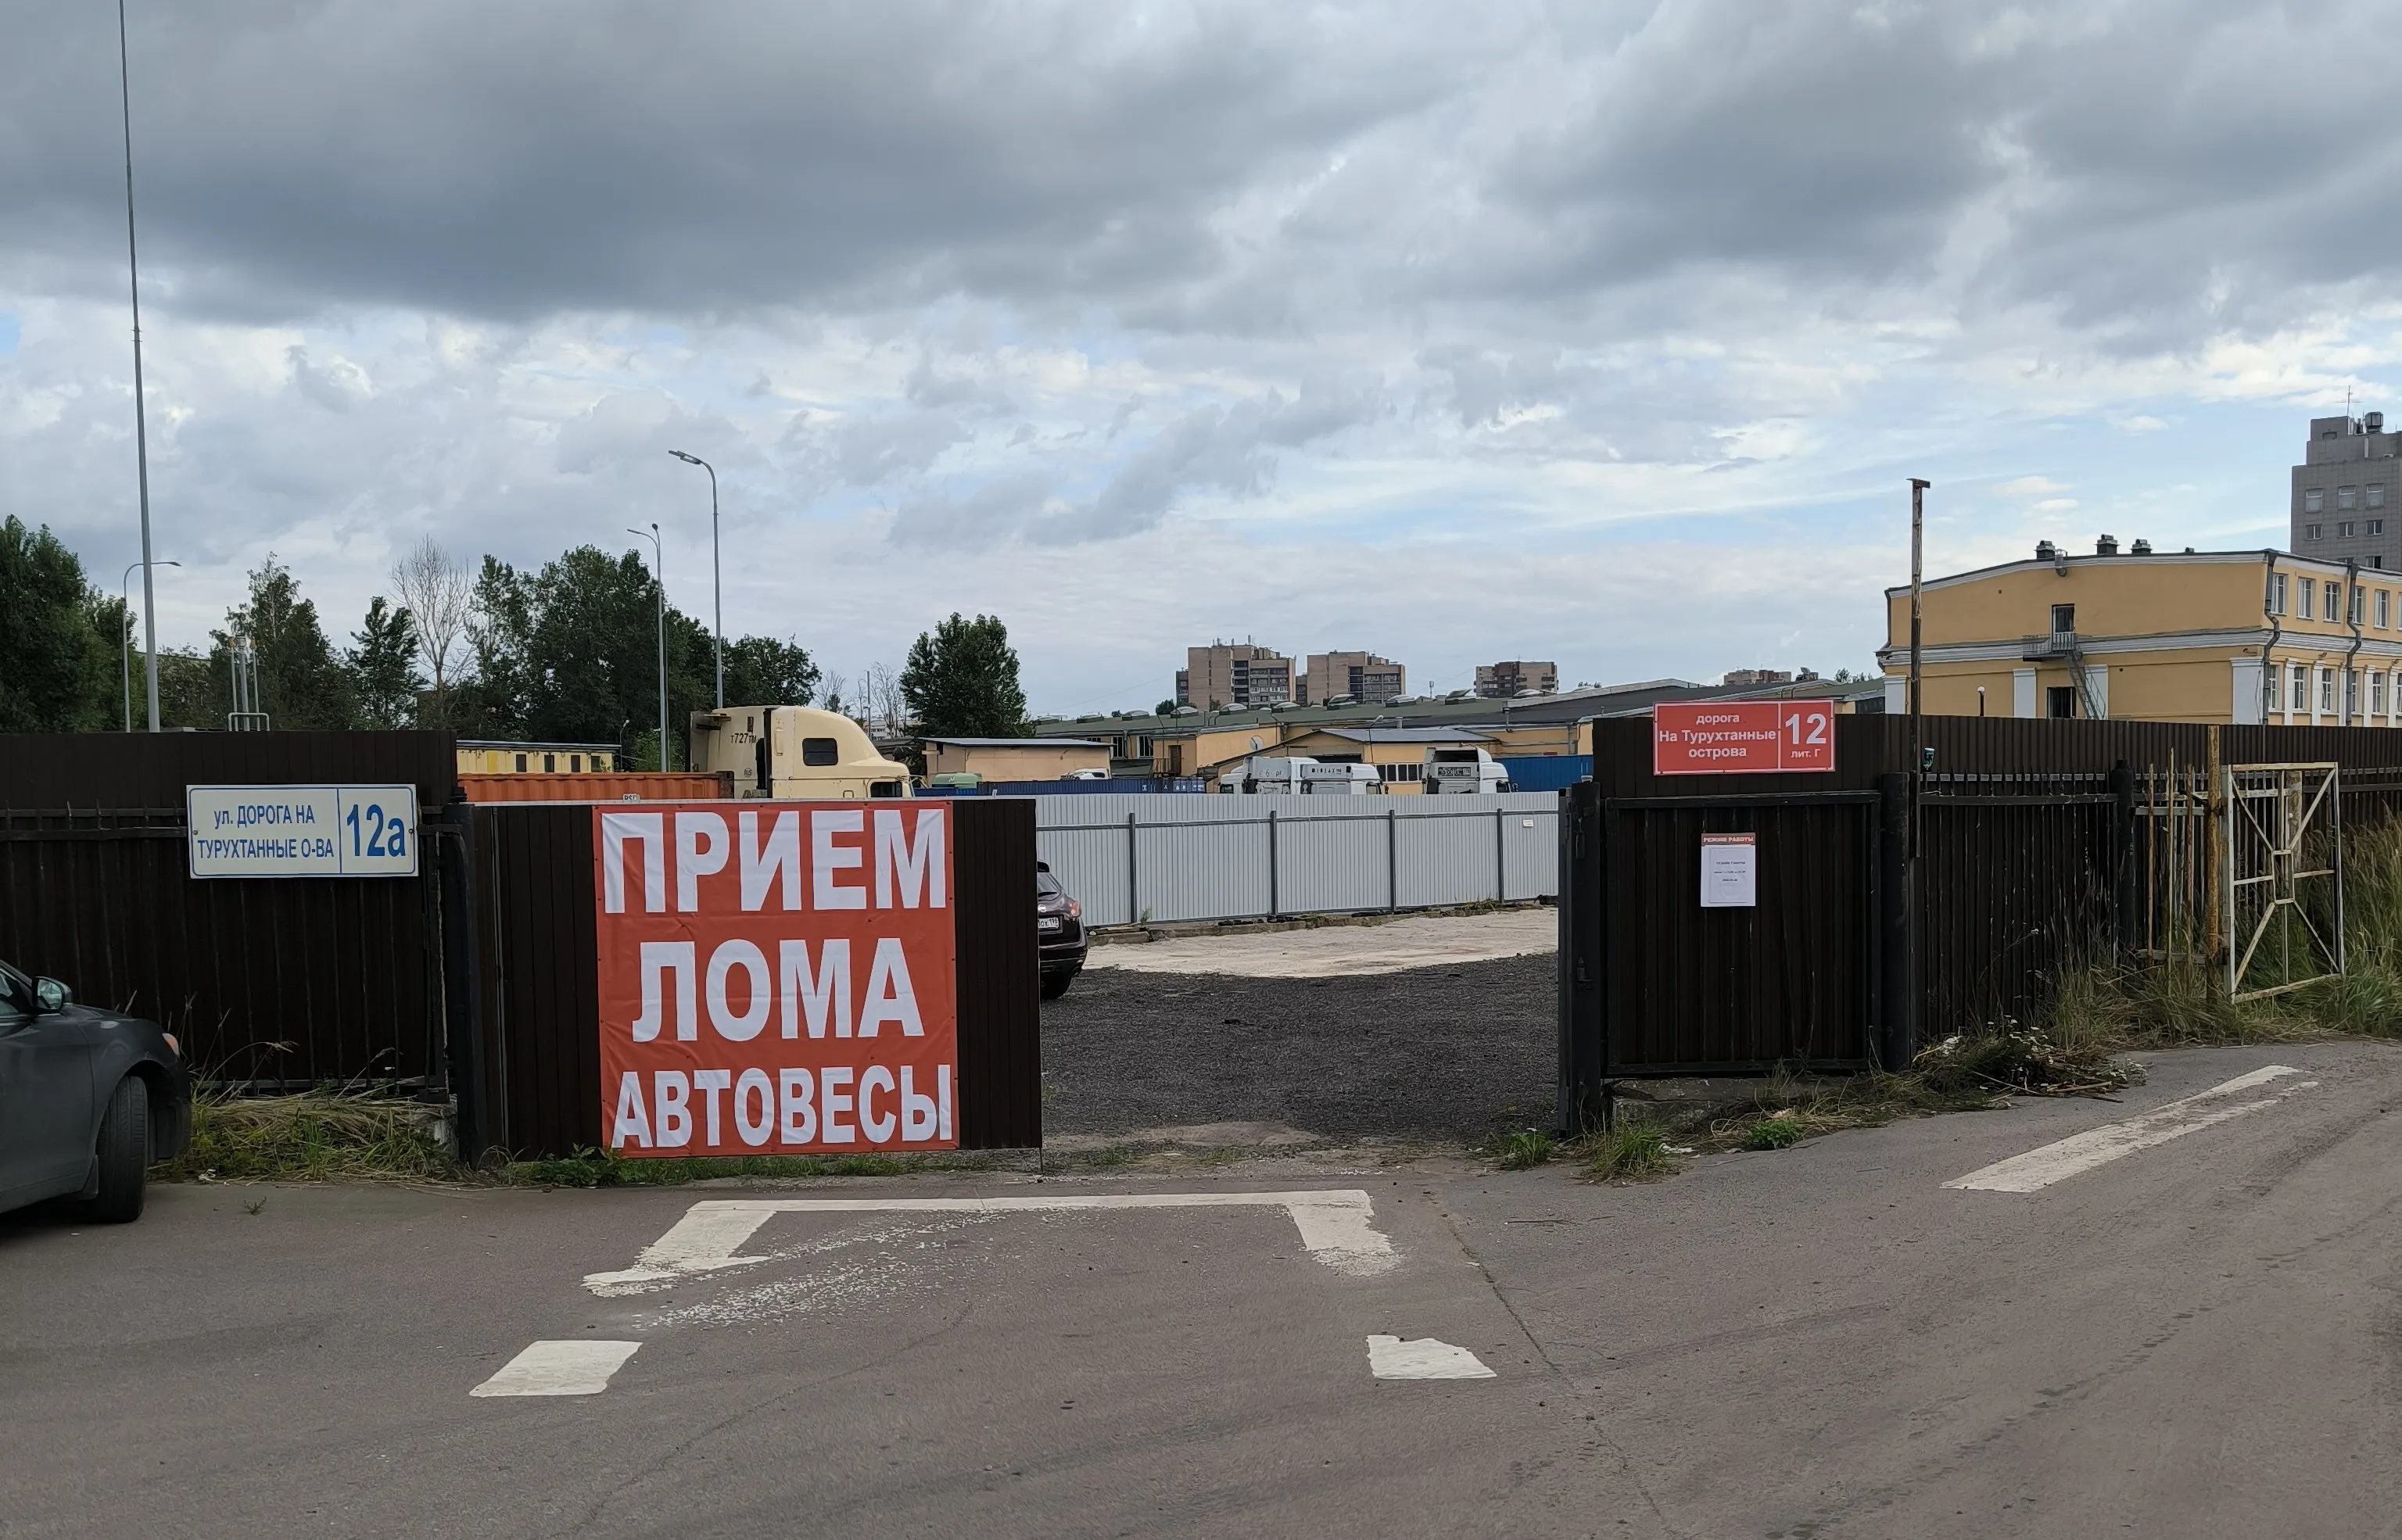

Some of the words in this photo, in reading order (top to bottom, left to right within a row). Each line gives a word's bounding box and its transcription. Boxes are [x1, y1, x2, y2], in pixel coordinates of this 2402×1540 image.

[1696, 714, 1740, 725] дорога
[1785, 713, 1827, 745] 12
[1659, 730, 1678, 742] На
[1681, 729, 1776, 745] Турухтанные
[1688, 747, 1747, 760] острова
[1791, 750, 1812, 758] лит.
[1814, 748, 1821, 757] Г
[213, 810, 234, 829] ул.
[237, 805, 292, 828] ДОРОГА
[296, 804, 315, 824] НА
[346, 804, 406, 858] 12а
[197, 838, 297, 859] ТУРУХТАННЫЕ
[301, 838, 334, 858] О-ВА
[601, 809, 946, 913] ПРИЕМ
[632, 938, 925, 1042] ЛОМА
[611, 1064, 952, 1148] АВТОВЕСЫ
